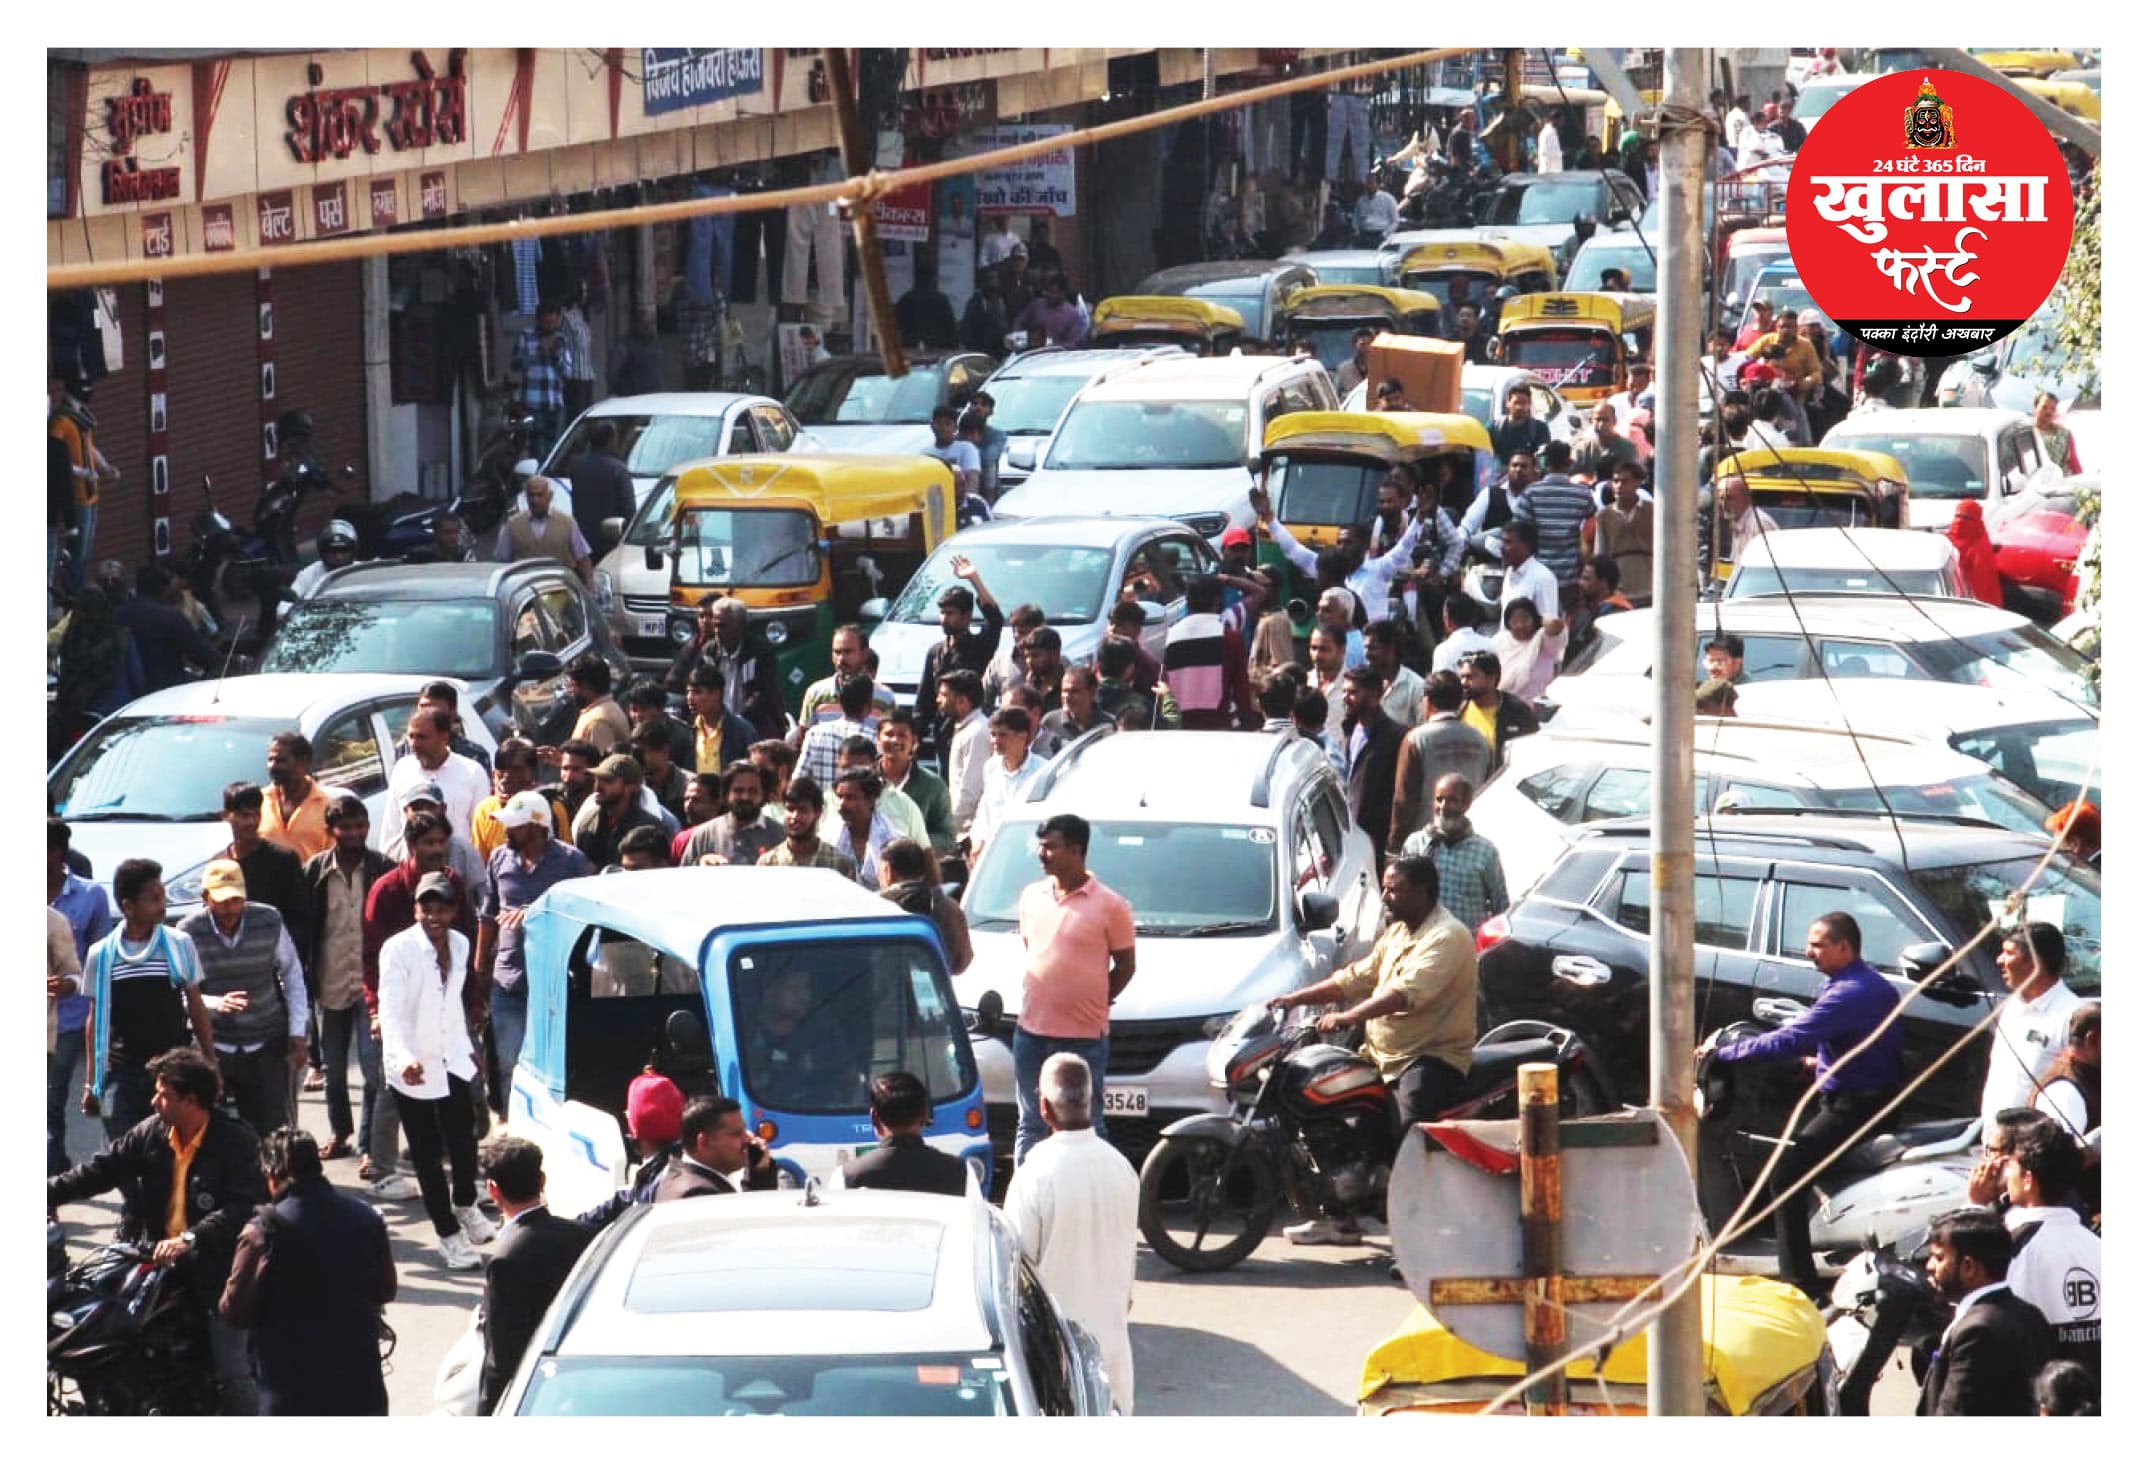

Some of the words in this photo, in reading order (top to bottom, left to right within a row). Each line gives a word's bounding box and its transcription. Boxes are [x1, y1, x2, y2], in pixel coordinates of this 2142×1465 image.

[284, 62, 381, 164] शंकर
[261, 201, 291, 238] बेल्ट
[318, 187, 343, 229] पर्स
[1104, 1093, 1146, 1111] 3548
